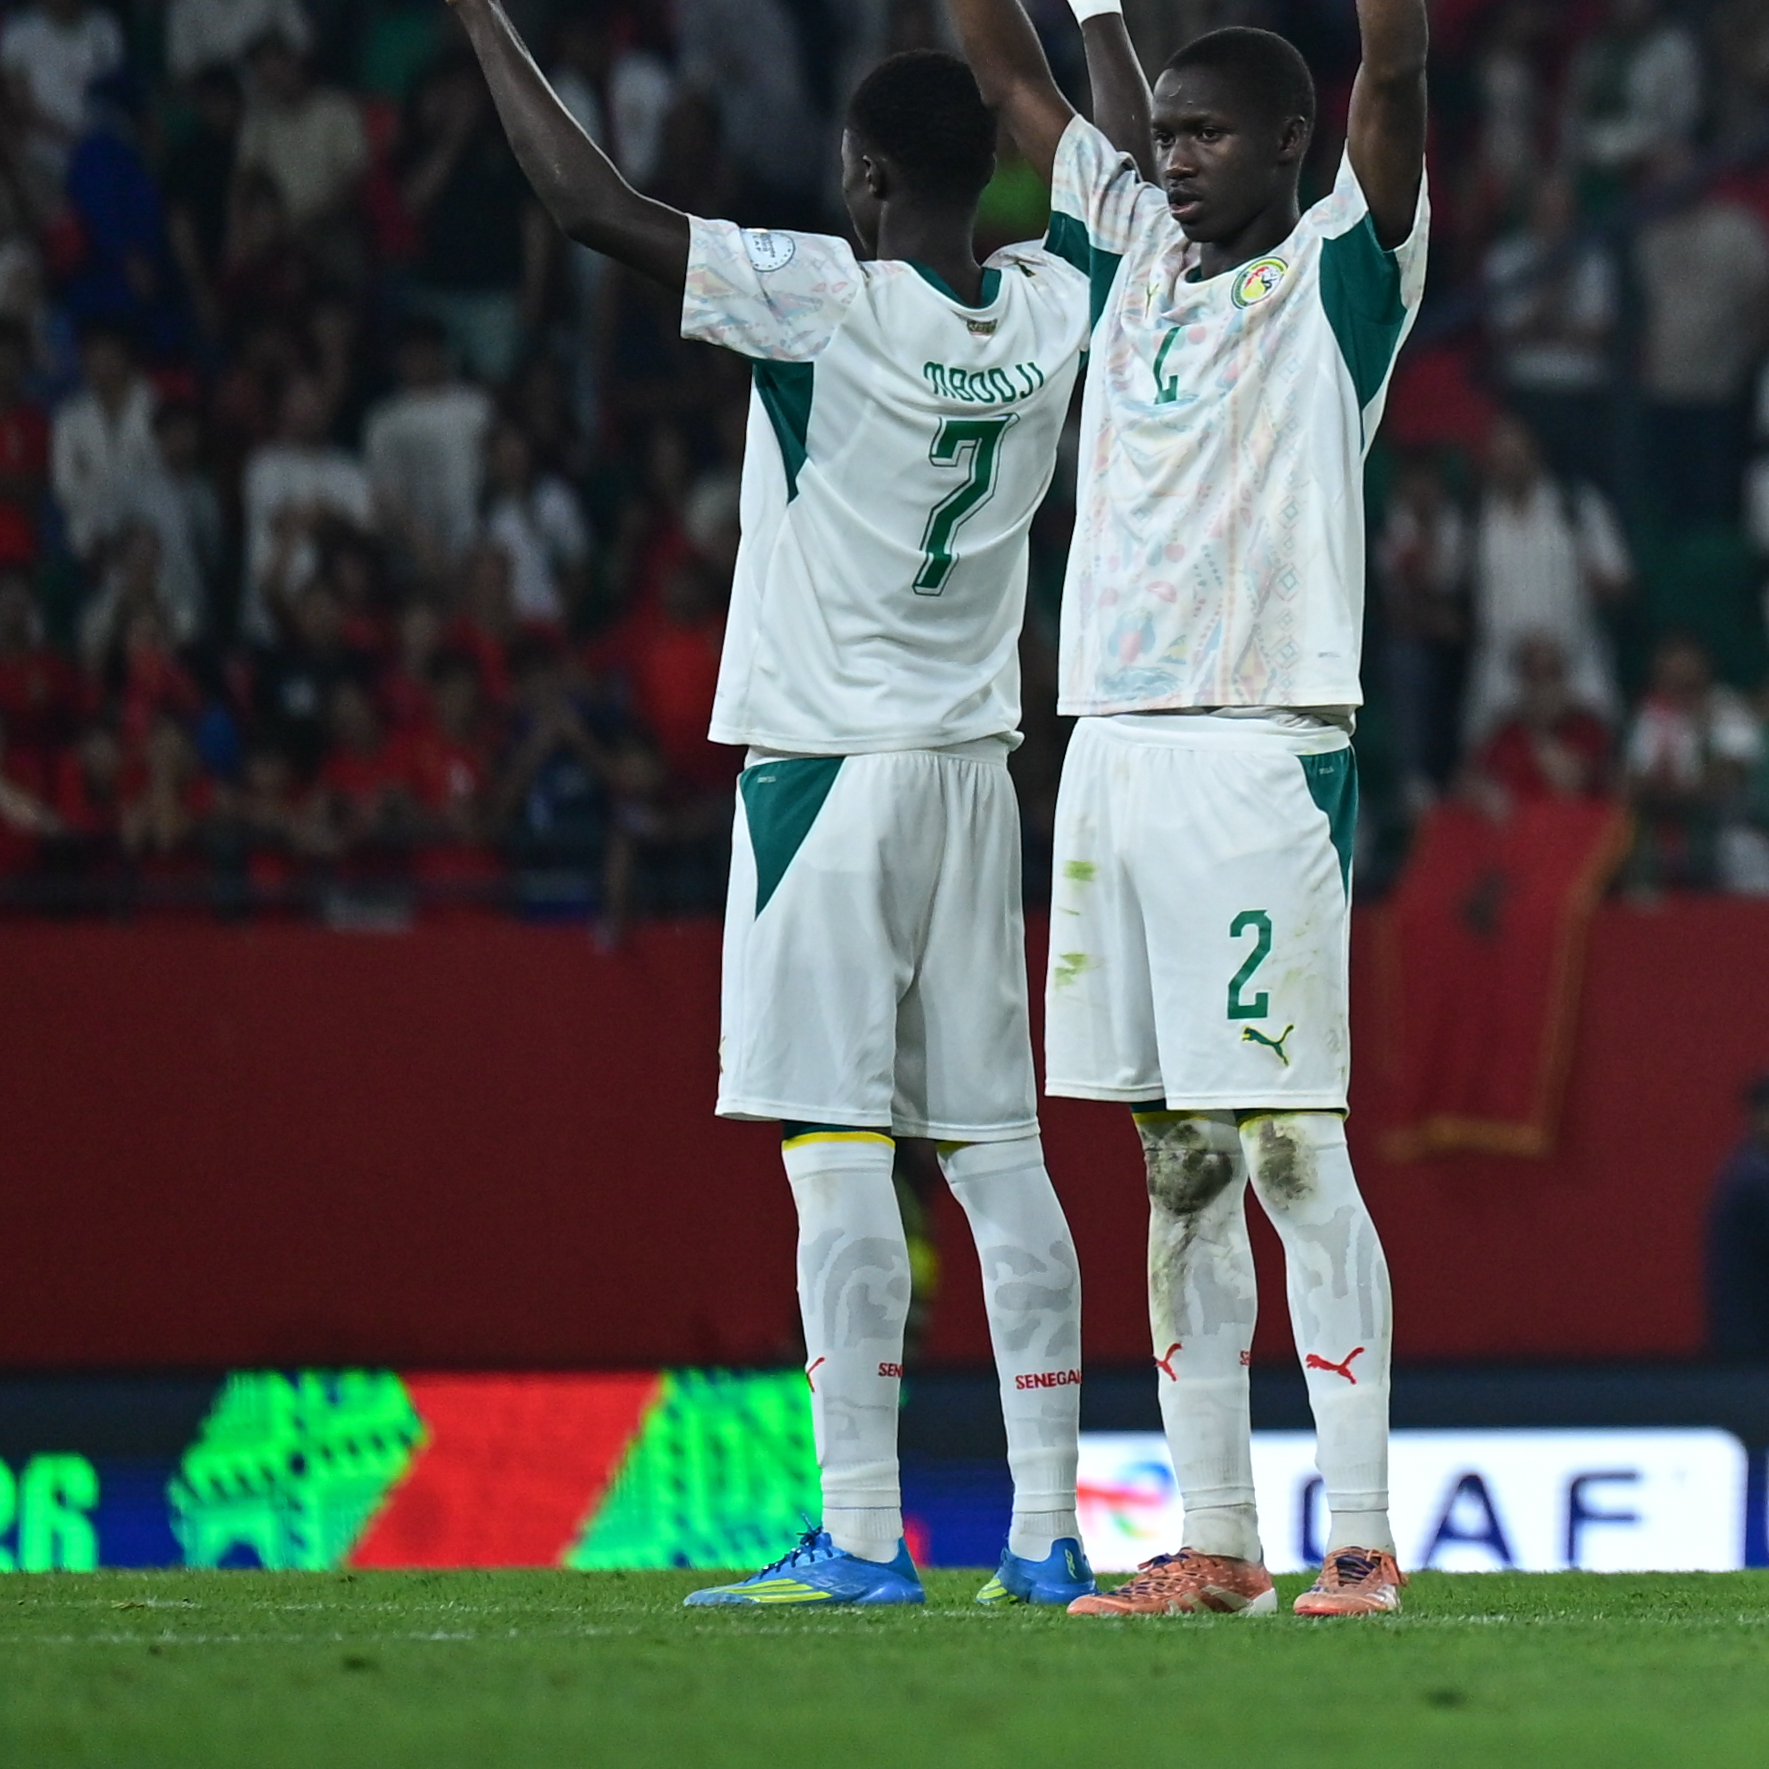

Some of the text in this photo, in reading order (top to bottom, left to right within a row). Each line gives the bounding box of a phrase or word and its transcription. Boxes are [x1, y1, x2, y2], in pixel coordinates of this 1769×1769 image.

[912, 412, 1021, 597] 7
[1226, 909, 1273, 1021] 2
[0, 1453, 100, 1572] 6
